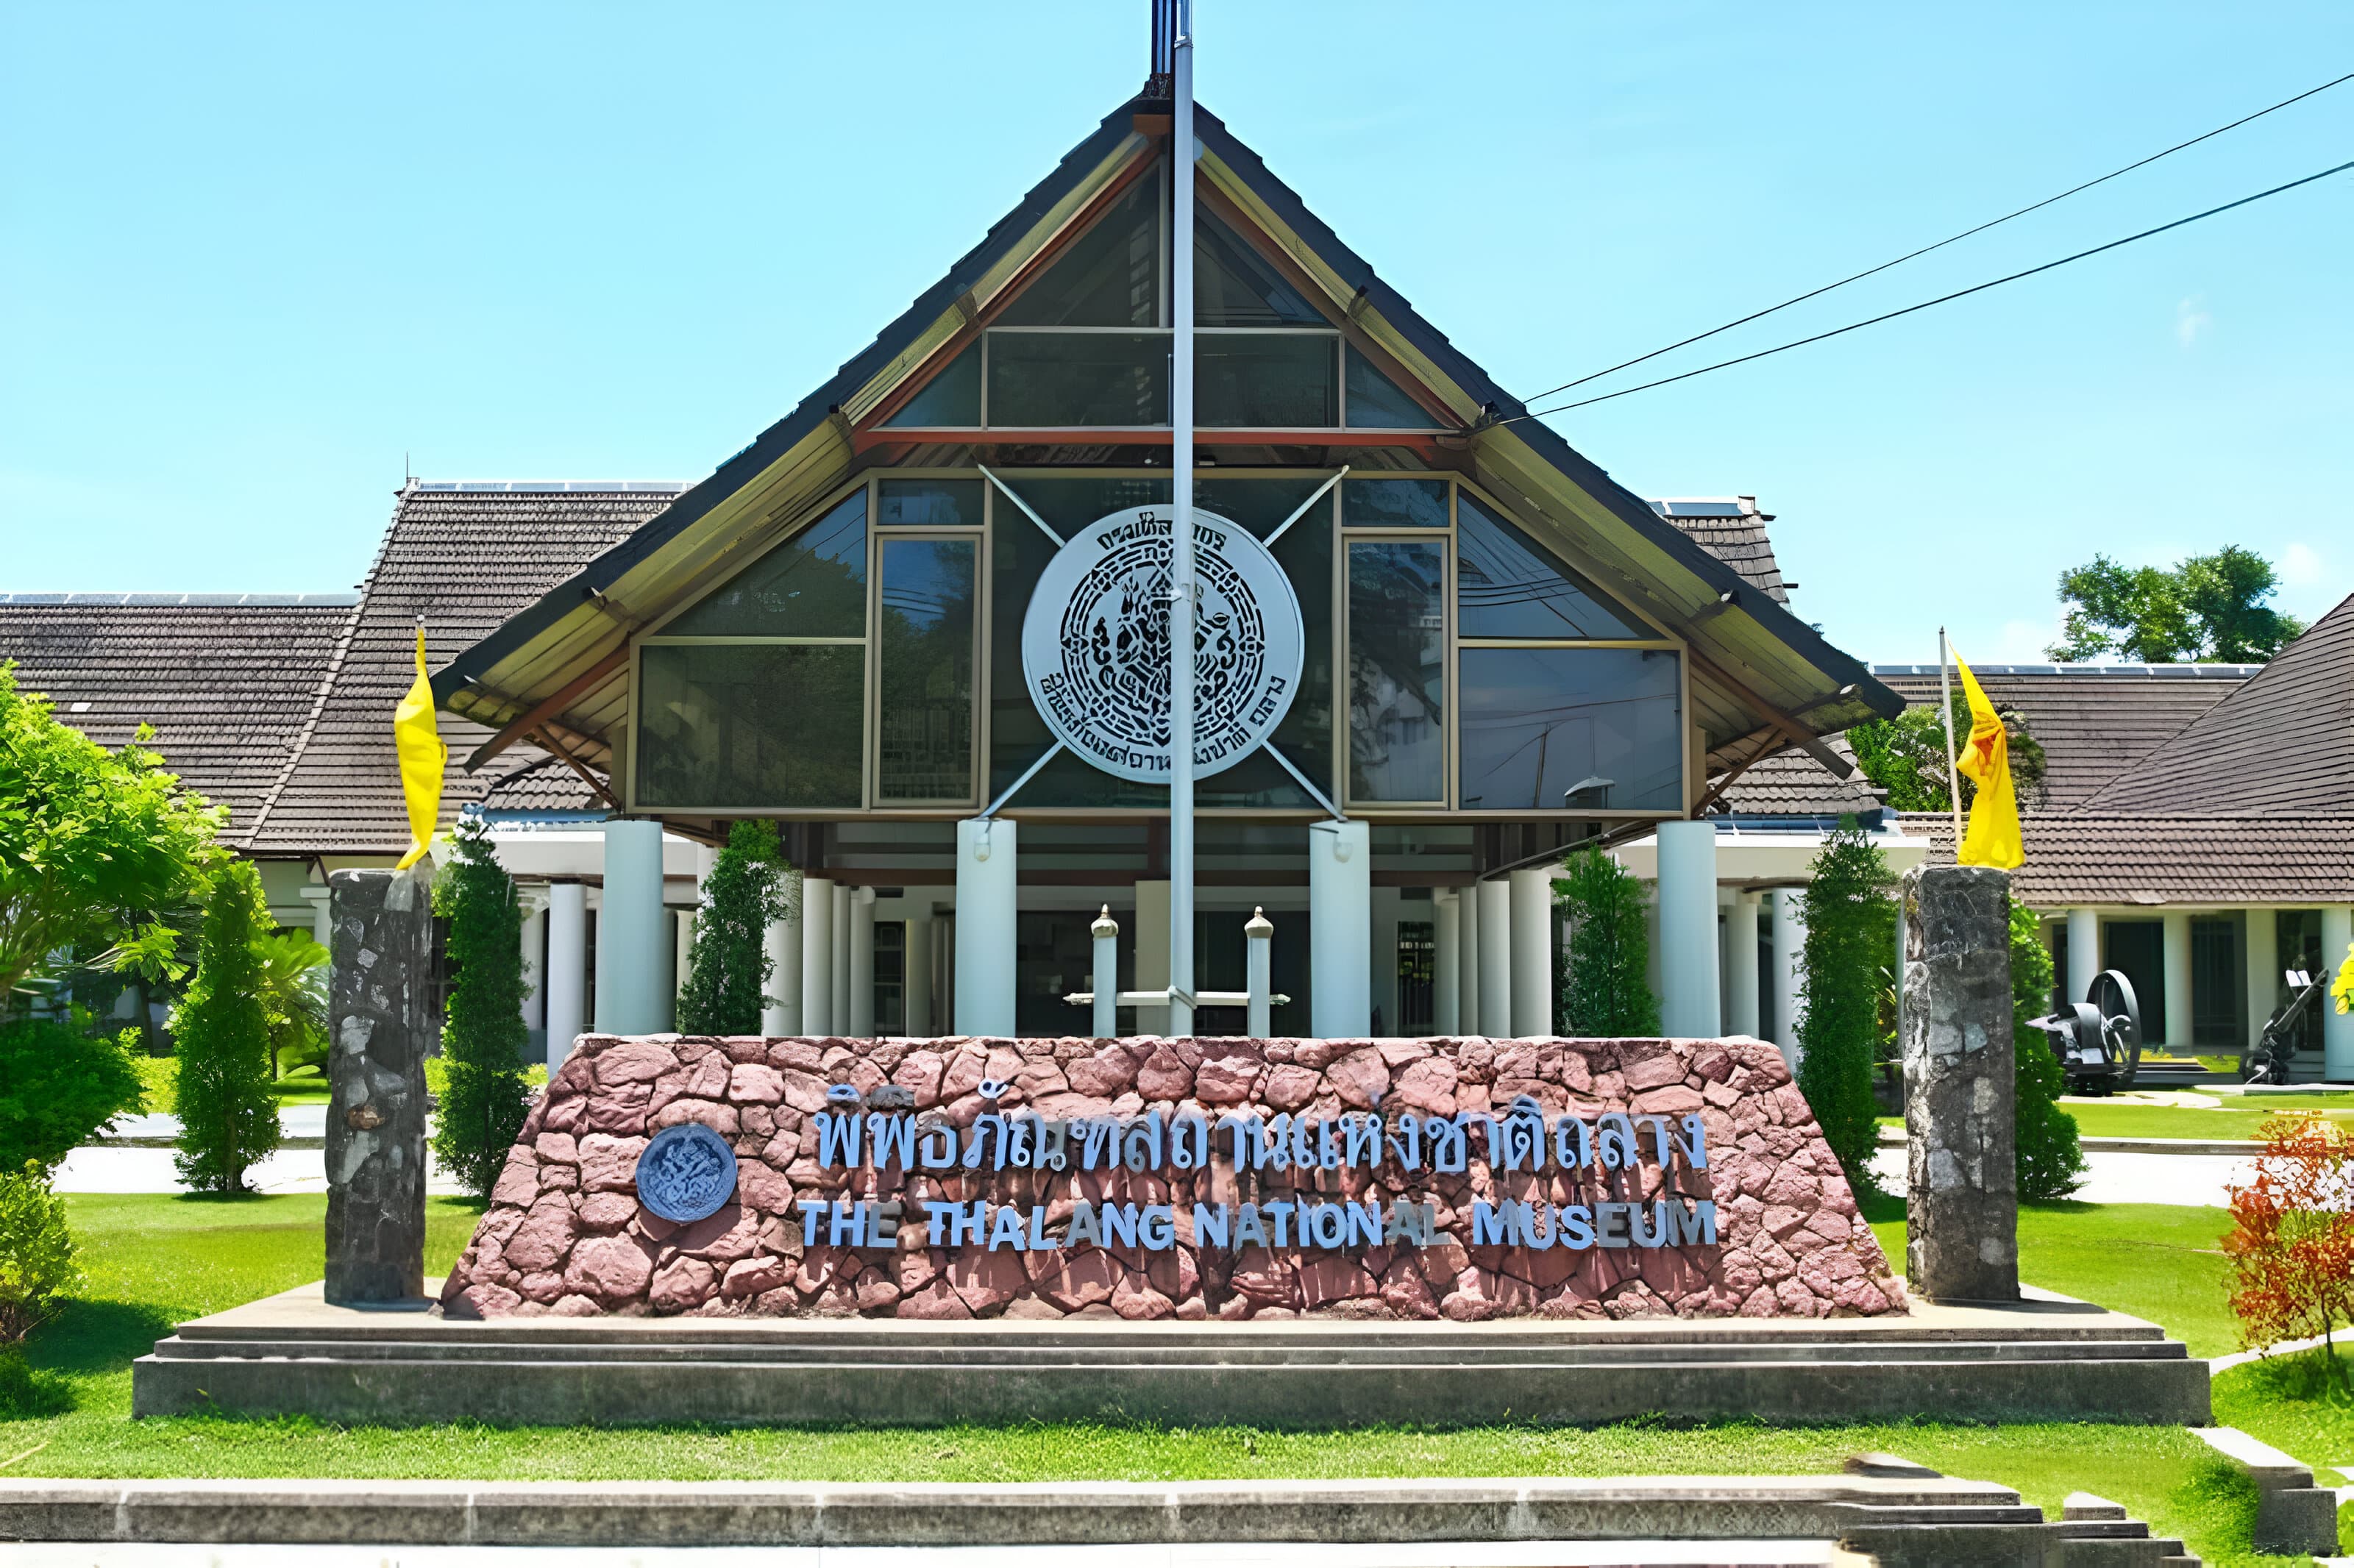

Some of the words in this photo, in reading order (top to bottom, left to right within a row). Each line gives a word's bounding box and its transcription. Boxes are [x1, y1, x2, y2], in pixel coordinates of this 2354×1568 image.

[797, 1199, 903, 1247] THE
[922, 1199, 1174, 1251] THALANG
[1194, 1198, 1458, 1250] NATIONAL
[1473, 1197, 1717, 1250] MUSEUM
